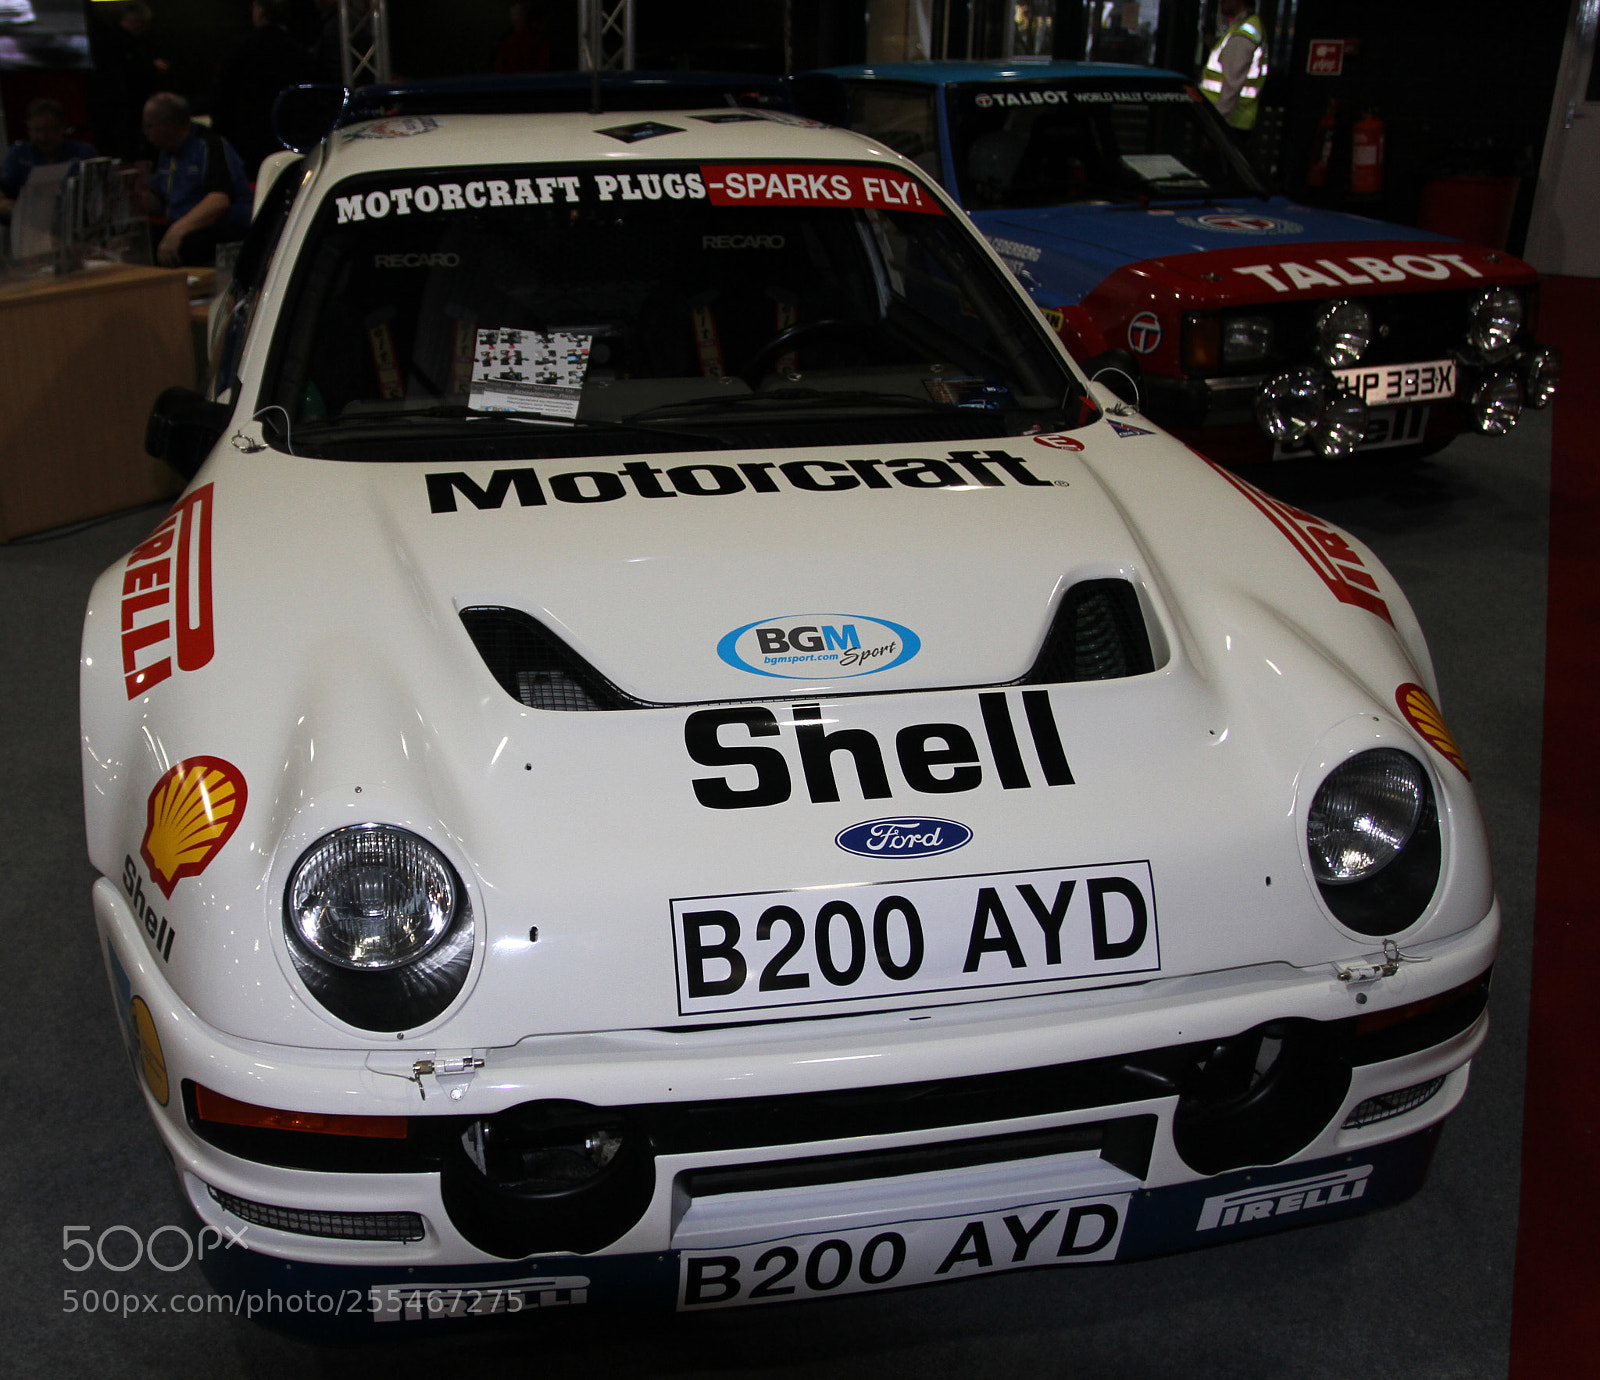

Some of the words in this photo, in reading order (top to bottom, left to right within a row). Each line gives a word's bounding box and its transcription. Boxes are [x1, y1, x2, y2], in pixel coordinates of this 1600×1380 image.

[991, 90, 1069, 107] TALBOT
[1073, 91, 1114, 103] WORLD
[1113, 91, 1143, 103] RALLY
[335, 175, 581, 225] MOTORCRAFT
[593, 172, 708, 202] PLUGS
[862, 176, 924, 206] FLY!
[373, 252, 461, 269] RECARO
[700, 234, 788, 250] RECARO
[1232, 253, 1484, 293] TALBOT
[1335, 373, 1379, 401] HP
[756, 624, 861, 654] BGM
[764, 654, 839, 665] bgmsport.com
[839, 641, 896, 666] Sport
[684, 690, 1076, 810] Shell
[866, 822, 944, 851] Ford
[122, 853, 175, 964] Shell
[682, 895, 924, 999] B200
[962, 876, 1148, 973] AYD
[1196, 1164, 1374, 1232] PIRELLI
[686, 1231, 906, 1306] B200
[935, 1203, 1119, 1274] AYD
[371, 1276, 592, 1323] PIRELLI
